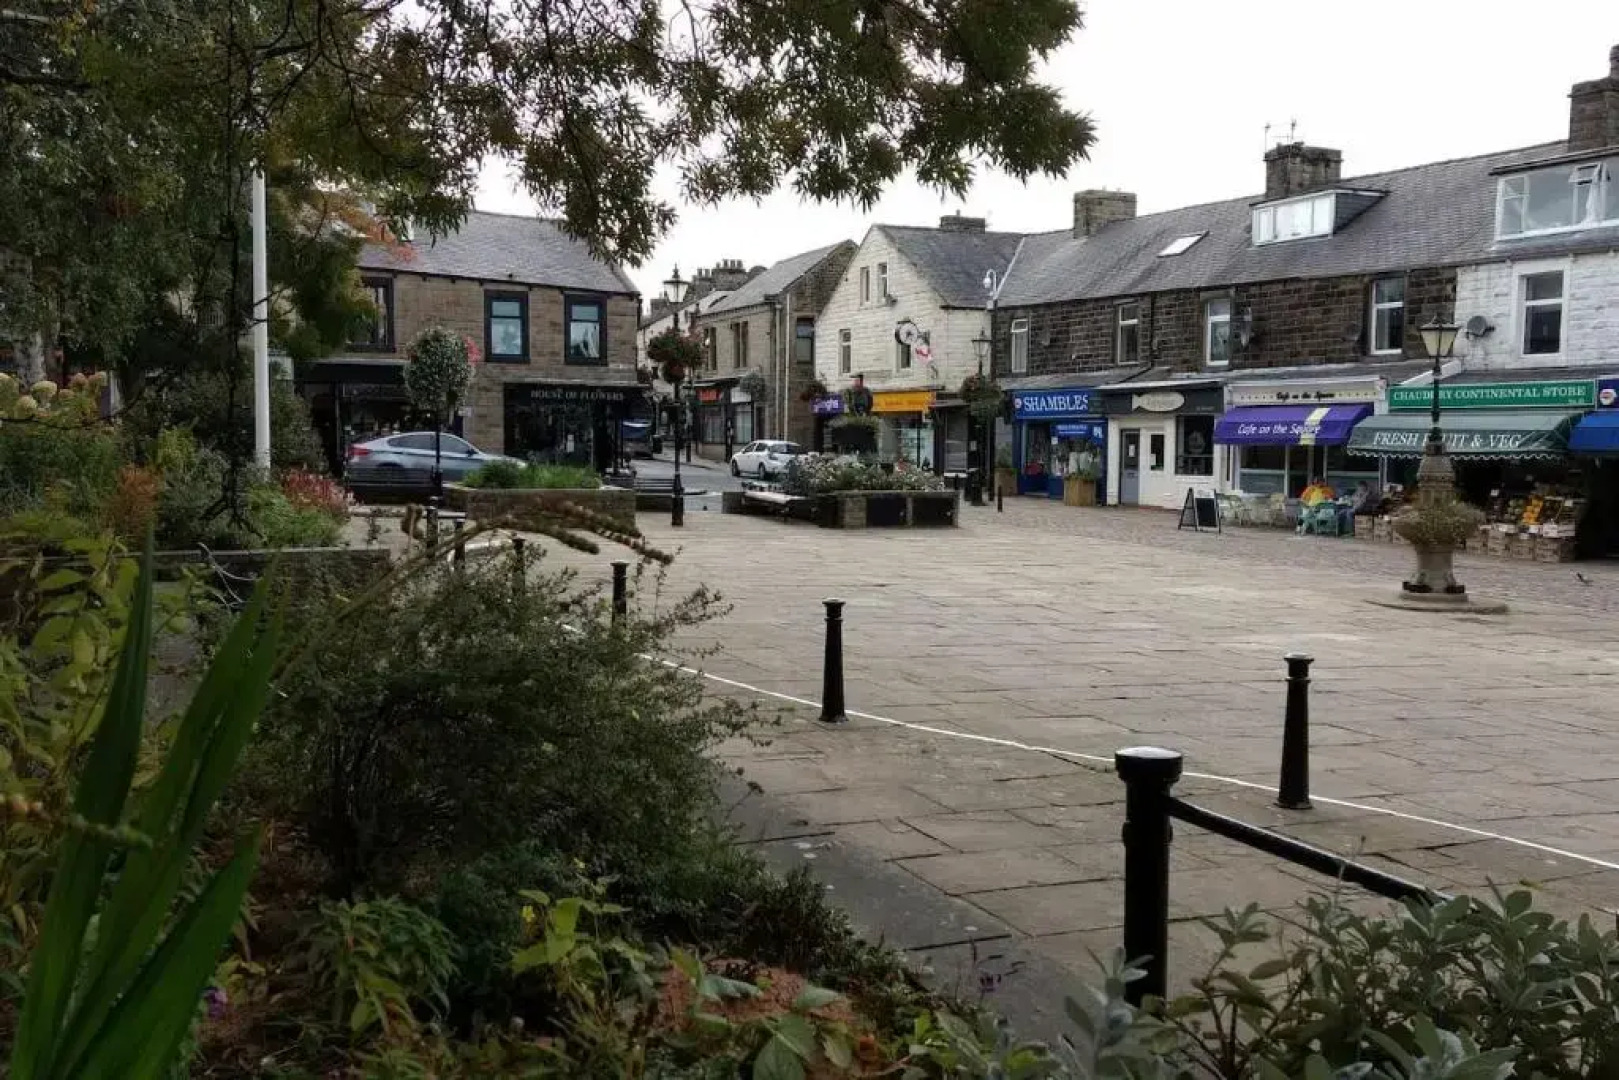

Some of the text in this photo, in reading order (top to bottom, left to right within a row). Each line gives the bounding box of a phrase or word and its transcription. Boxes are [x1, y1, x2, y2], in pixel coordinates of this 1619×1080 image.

[1394, 385, 1586, 400] CHAUDRY CONTINENTAL STORE
[1023, 395, 1088, 411] SHAMBLES
[1258, 426, 1270, 434] on
[1272, 423, 1288, 434] the
[1372, 431, 1521, 448] FRESH FUIT & VEG
